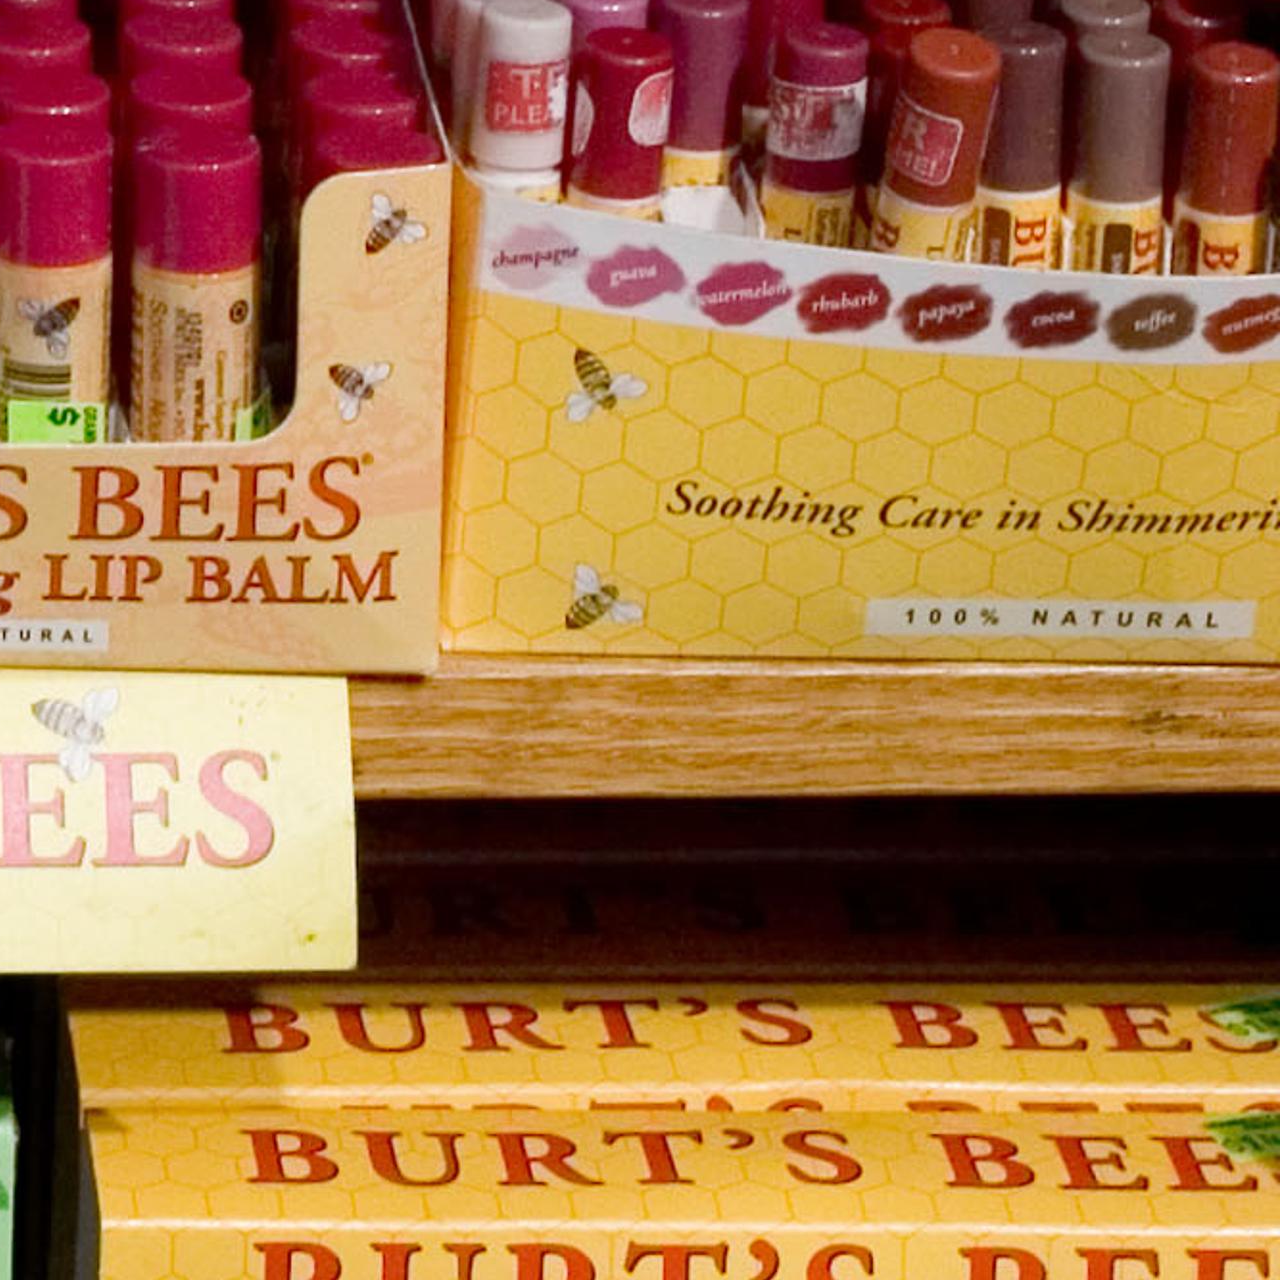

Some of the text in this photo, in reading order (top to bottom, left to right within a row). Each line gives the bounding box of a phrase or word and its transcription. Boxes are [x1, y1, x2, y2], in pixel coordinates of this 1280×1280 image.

[492, 245, 580, 269] champagne
[609, 264, 657, 287] guava
[811, 288, 879, 314] rhubarb
[918, 298, 976, 328] papaya
[1031, 307, 1076, 329] cocoa
[70, 456, 361, 543] BEES
[666, 480, 1042, 535] Soothing Care in
[41, 553, 162, 602] LIP
[185, 550, 397, 604] BALM
[905, 608, 1220, 629] 100% NATURAL
[244, 1127, 864, 1188] BURT'S
